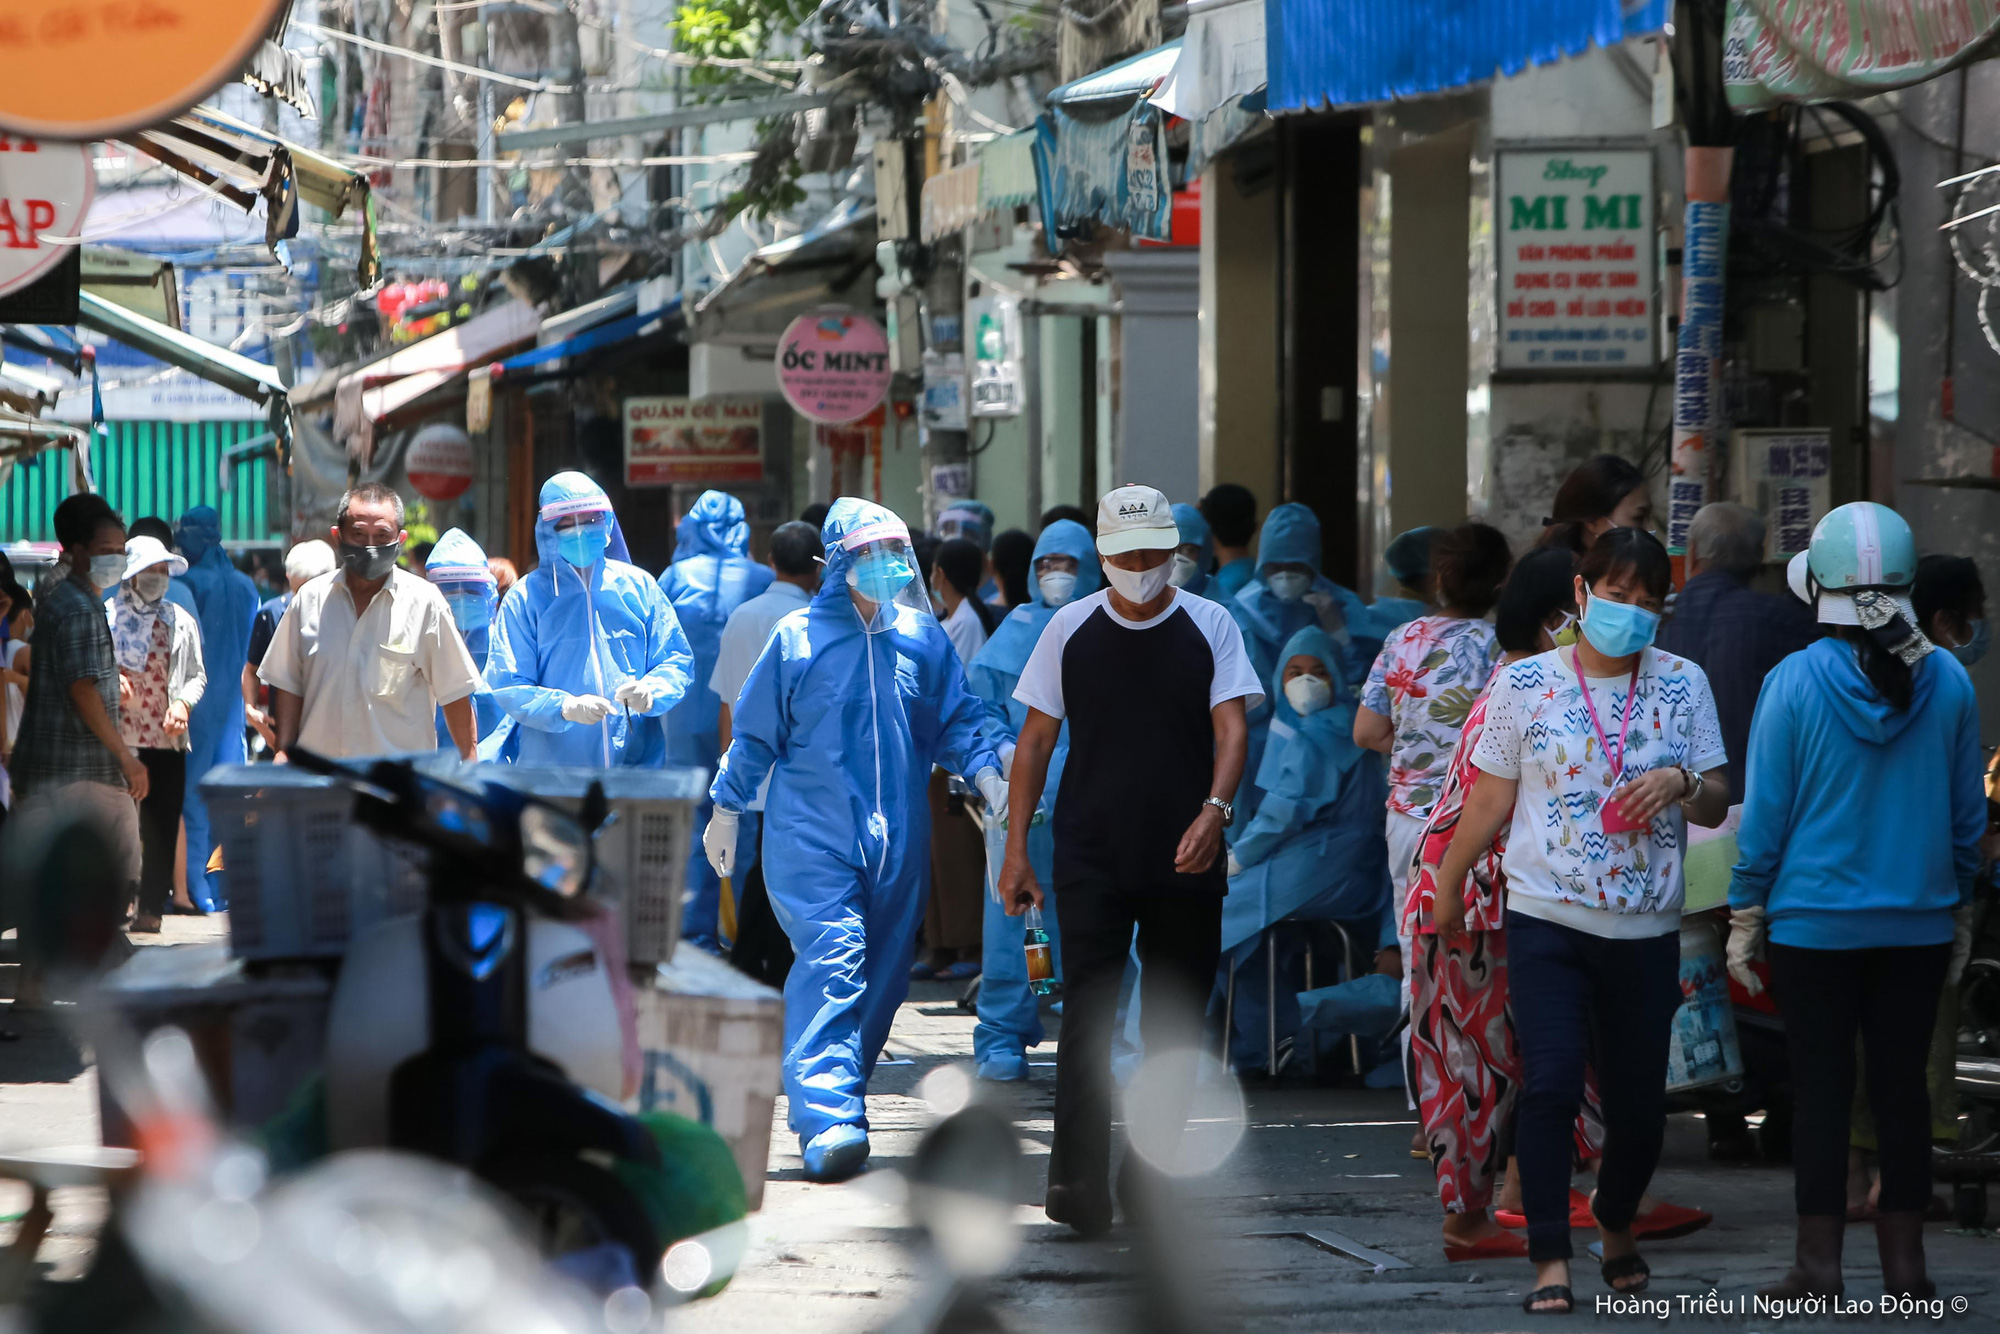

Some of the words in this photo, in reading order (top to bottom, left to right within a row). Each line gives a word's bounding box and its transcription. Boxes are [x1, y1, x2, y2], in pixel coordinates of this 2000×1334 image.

[1542, 159, 1608, 188] Shop
[1509, 195, 1568, 231] MI
[1582, 195, 1642, 230] MI
[823, 350, 888, 373] MINT
